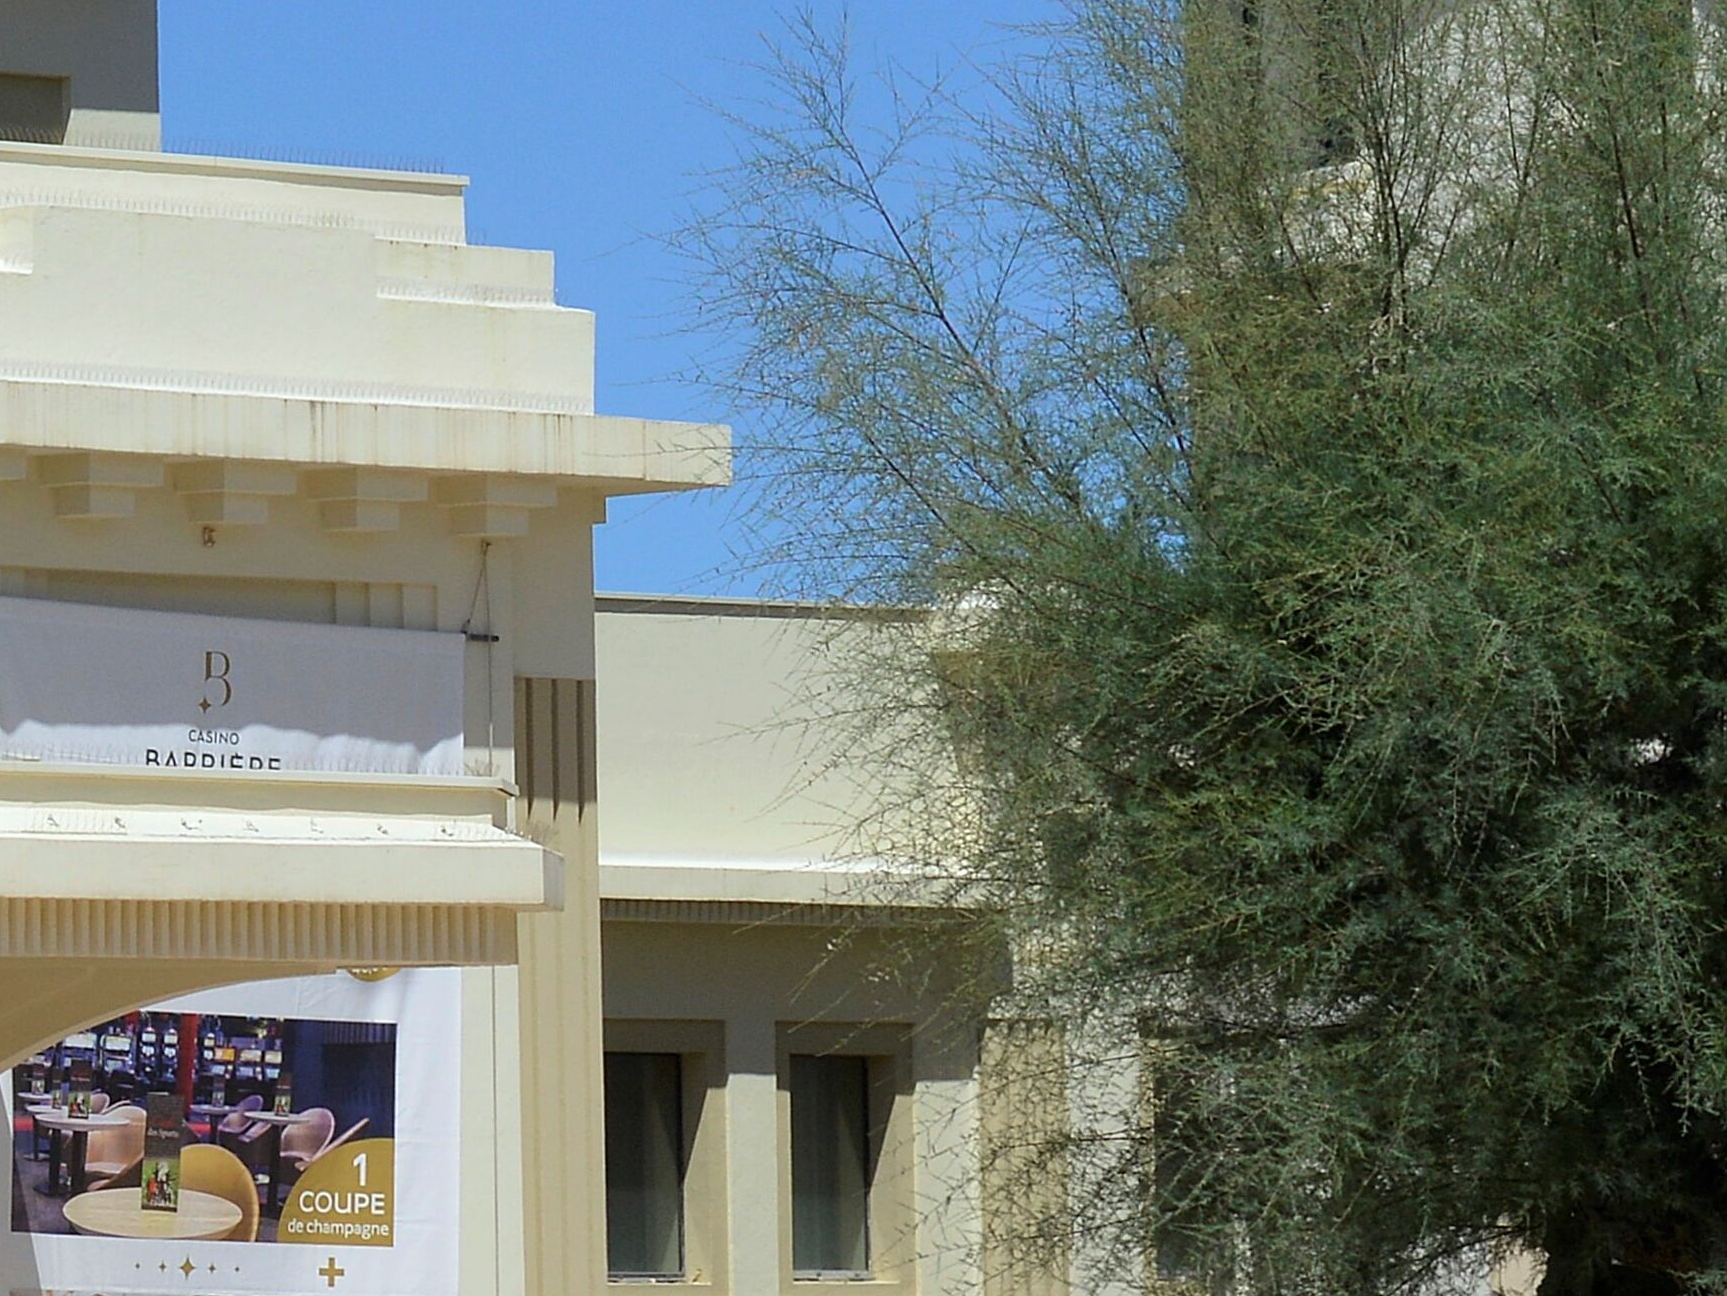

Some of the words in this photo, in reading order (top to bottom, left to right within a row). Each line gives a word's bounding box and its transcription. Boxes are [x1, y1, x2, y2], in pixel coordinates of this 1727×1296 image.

[188, 729, 240, 745] CASINO
[353, 1153, 367, 1186] 1
[299, 1191, 385, 1214] COUPE
[288, 1219, 304, 1233] de
[306, 1219, 389, 1239] champagne
